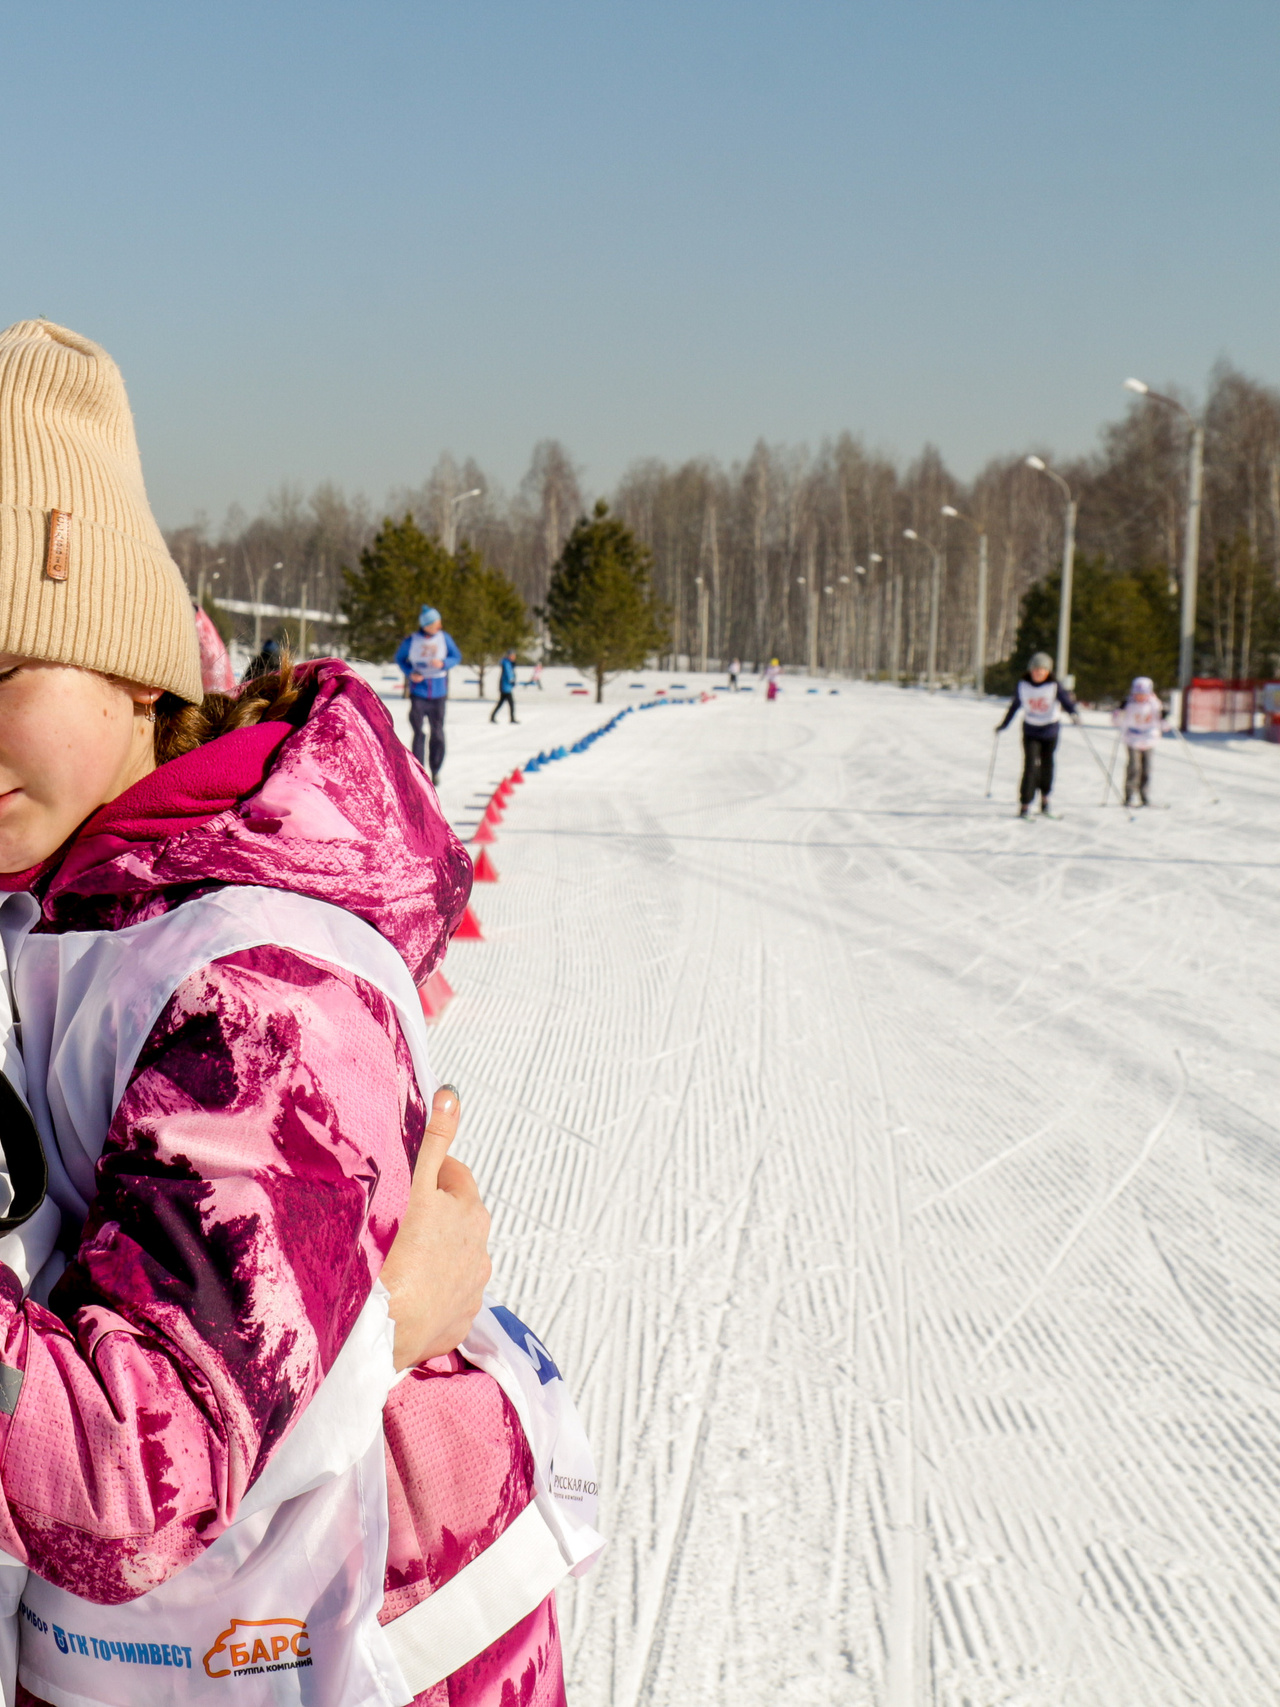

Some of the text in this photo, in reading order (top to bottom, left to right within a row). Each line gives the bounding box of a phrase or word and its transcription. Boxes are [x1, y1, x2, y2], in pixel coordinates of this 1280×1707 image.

[20, 1601, 49, 1634] РИБОР
[67, 1632, 192, 1669] ГК ТОЧИНВЕСТ
[229, 1631, 311, 1667] БАРС
[233, 1657, 313, 1677] ГРУППА КОМПАНИЙ
